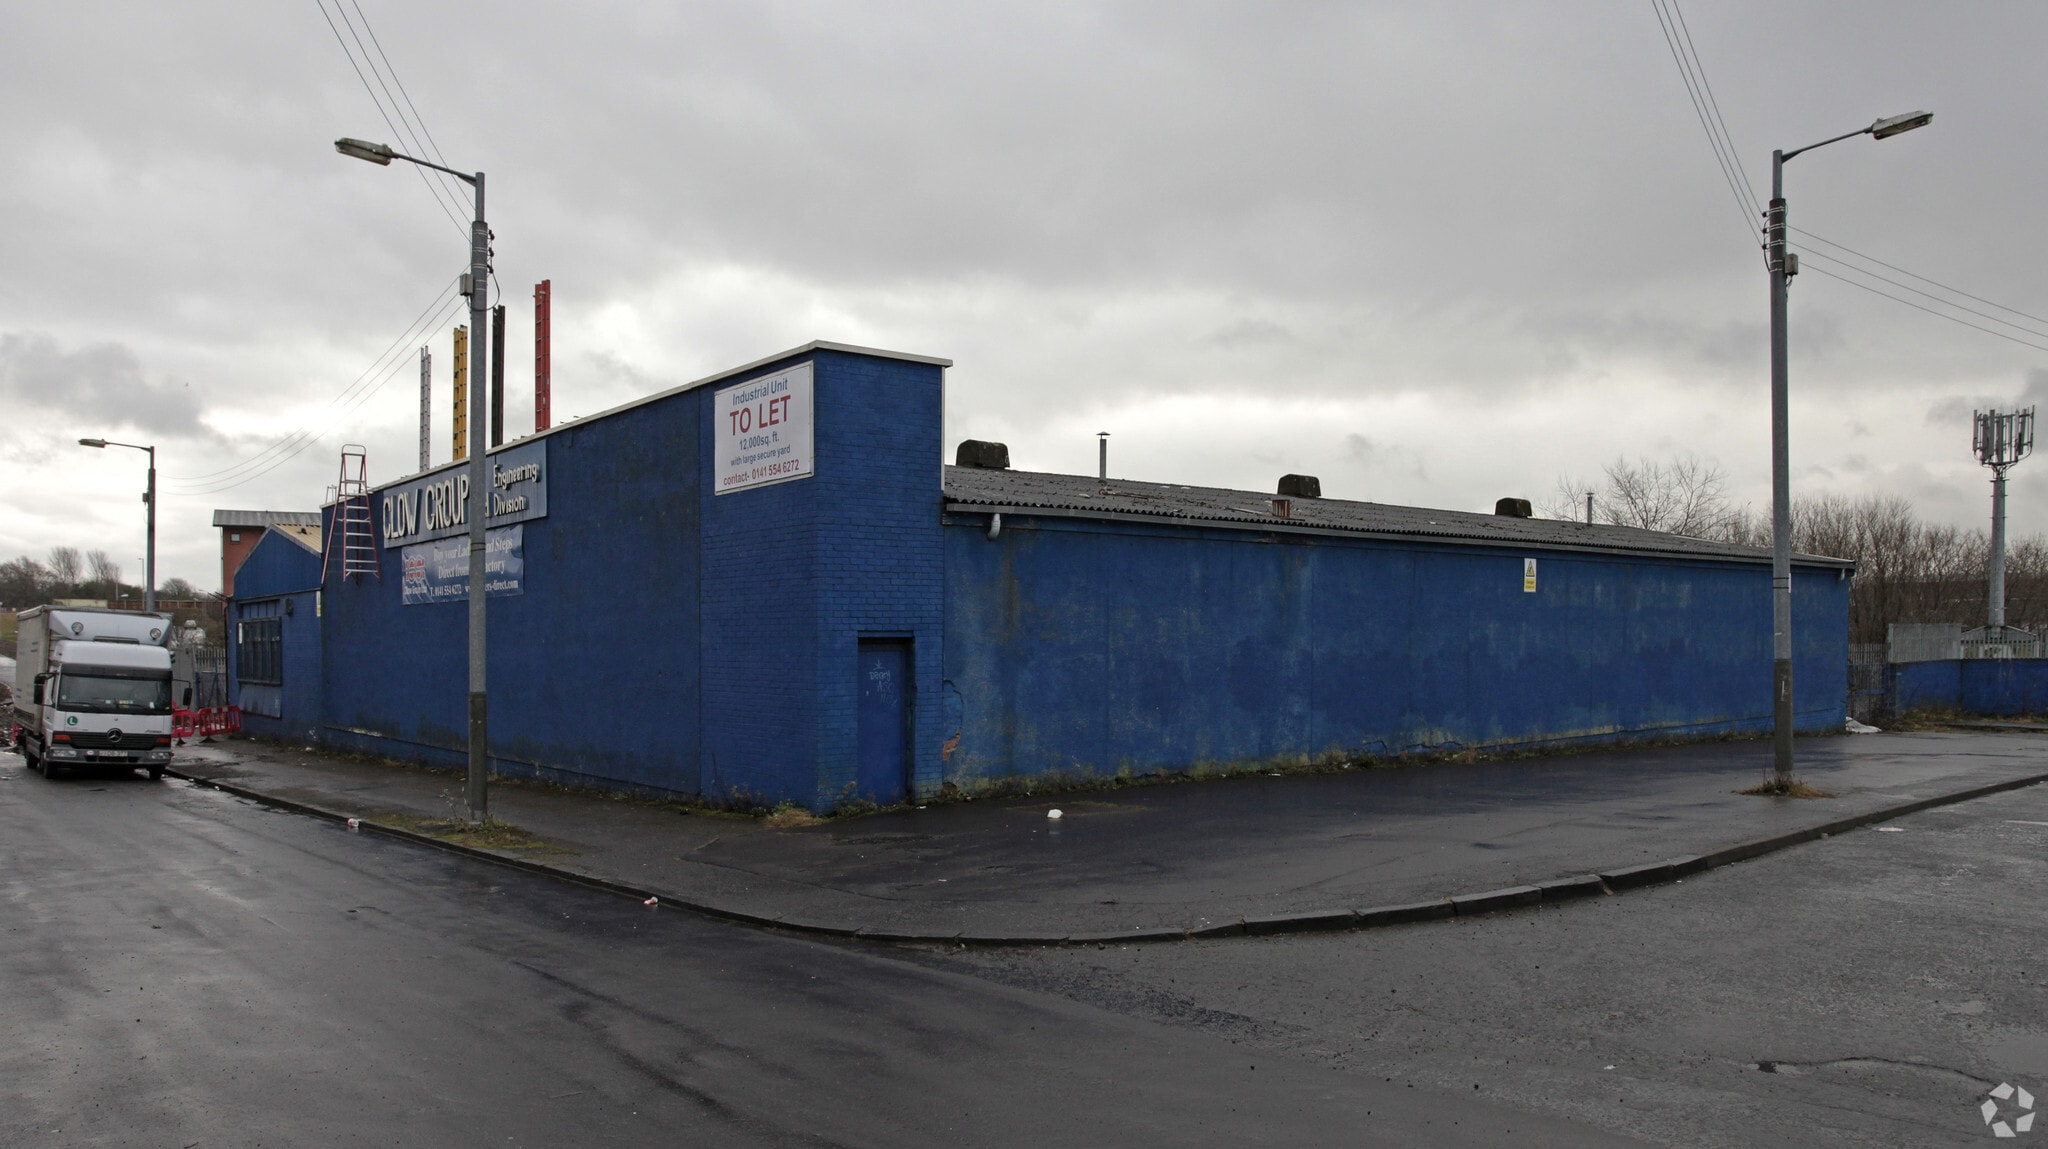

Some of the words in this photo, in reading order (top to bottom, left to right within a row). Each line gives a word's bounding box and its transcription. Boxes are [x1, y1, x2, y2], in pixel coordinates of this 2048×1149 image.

[732, 388, 769, 406] Industrial
[771, 378, 788, 394] Unit
[729, 407, 752, 436] TO
[758, 394, 792, 429] LET
[772, 431, 780, 443] ft.
[730, 455, 742, 467] with
[742, 454, 756, 465] large
[756, 450, 776, 461] secure
[777, 444, 791, 459] yard
[493, 463, 539, 490] Engineering
[723, 471, 749, 486] contact-
[751, 466, 767, 480] 0141
[768, 463, 782, 476] 554
[782, 459, 800, 473] 6272
[383, 488, 420, 540] CLOW
[425, 474, 470, 531] GROUP
[493, 493, 526, 516] Division
[443, 549, 458, 563] your
[495, 537, 513, 553] Steps
[438, 565, 455, 579] Direct
